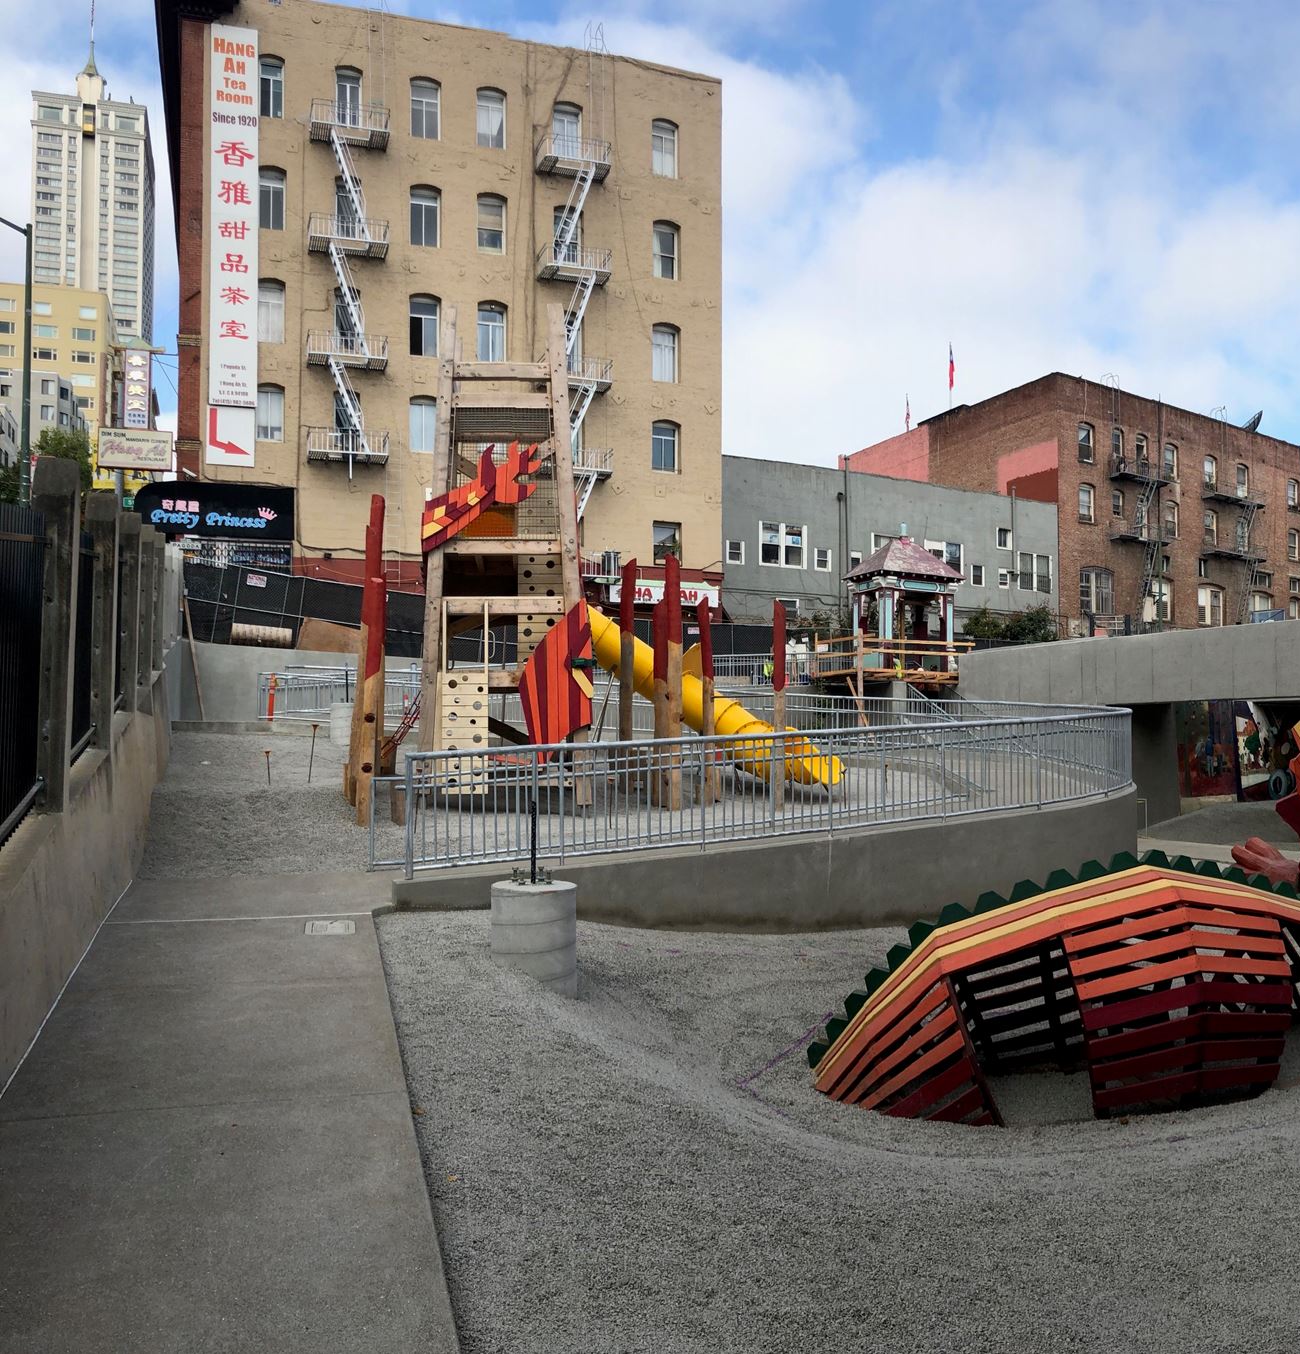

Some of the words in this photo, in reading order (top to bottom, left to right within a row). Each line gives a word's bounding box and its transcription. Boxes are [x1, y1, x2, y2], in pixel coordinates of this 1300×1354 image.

[213, 37, 255, 58] HANG
[223, 76, 247, 91] Tea
[216, 90, 253, 105] Room
[212, 112, 236, 125] Since
[237, 115, 257, 127] 1920
[151, 509, 200, 529] Pretty
[205, 512, 268, 528] Princess
